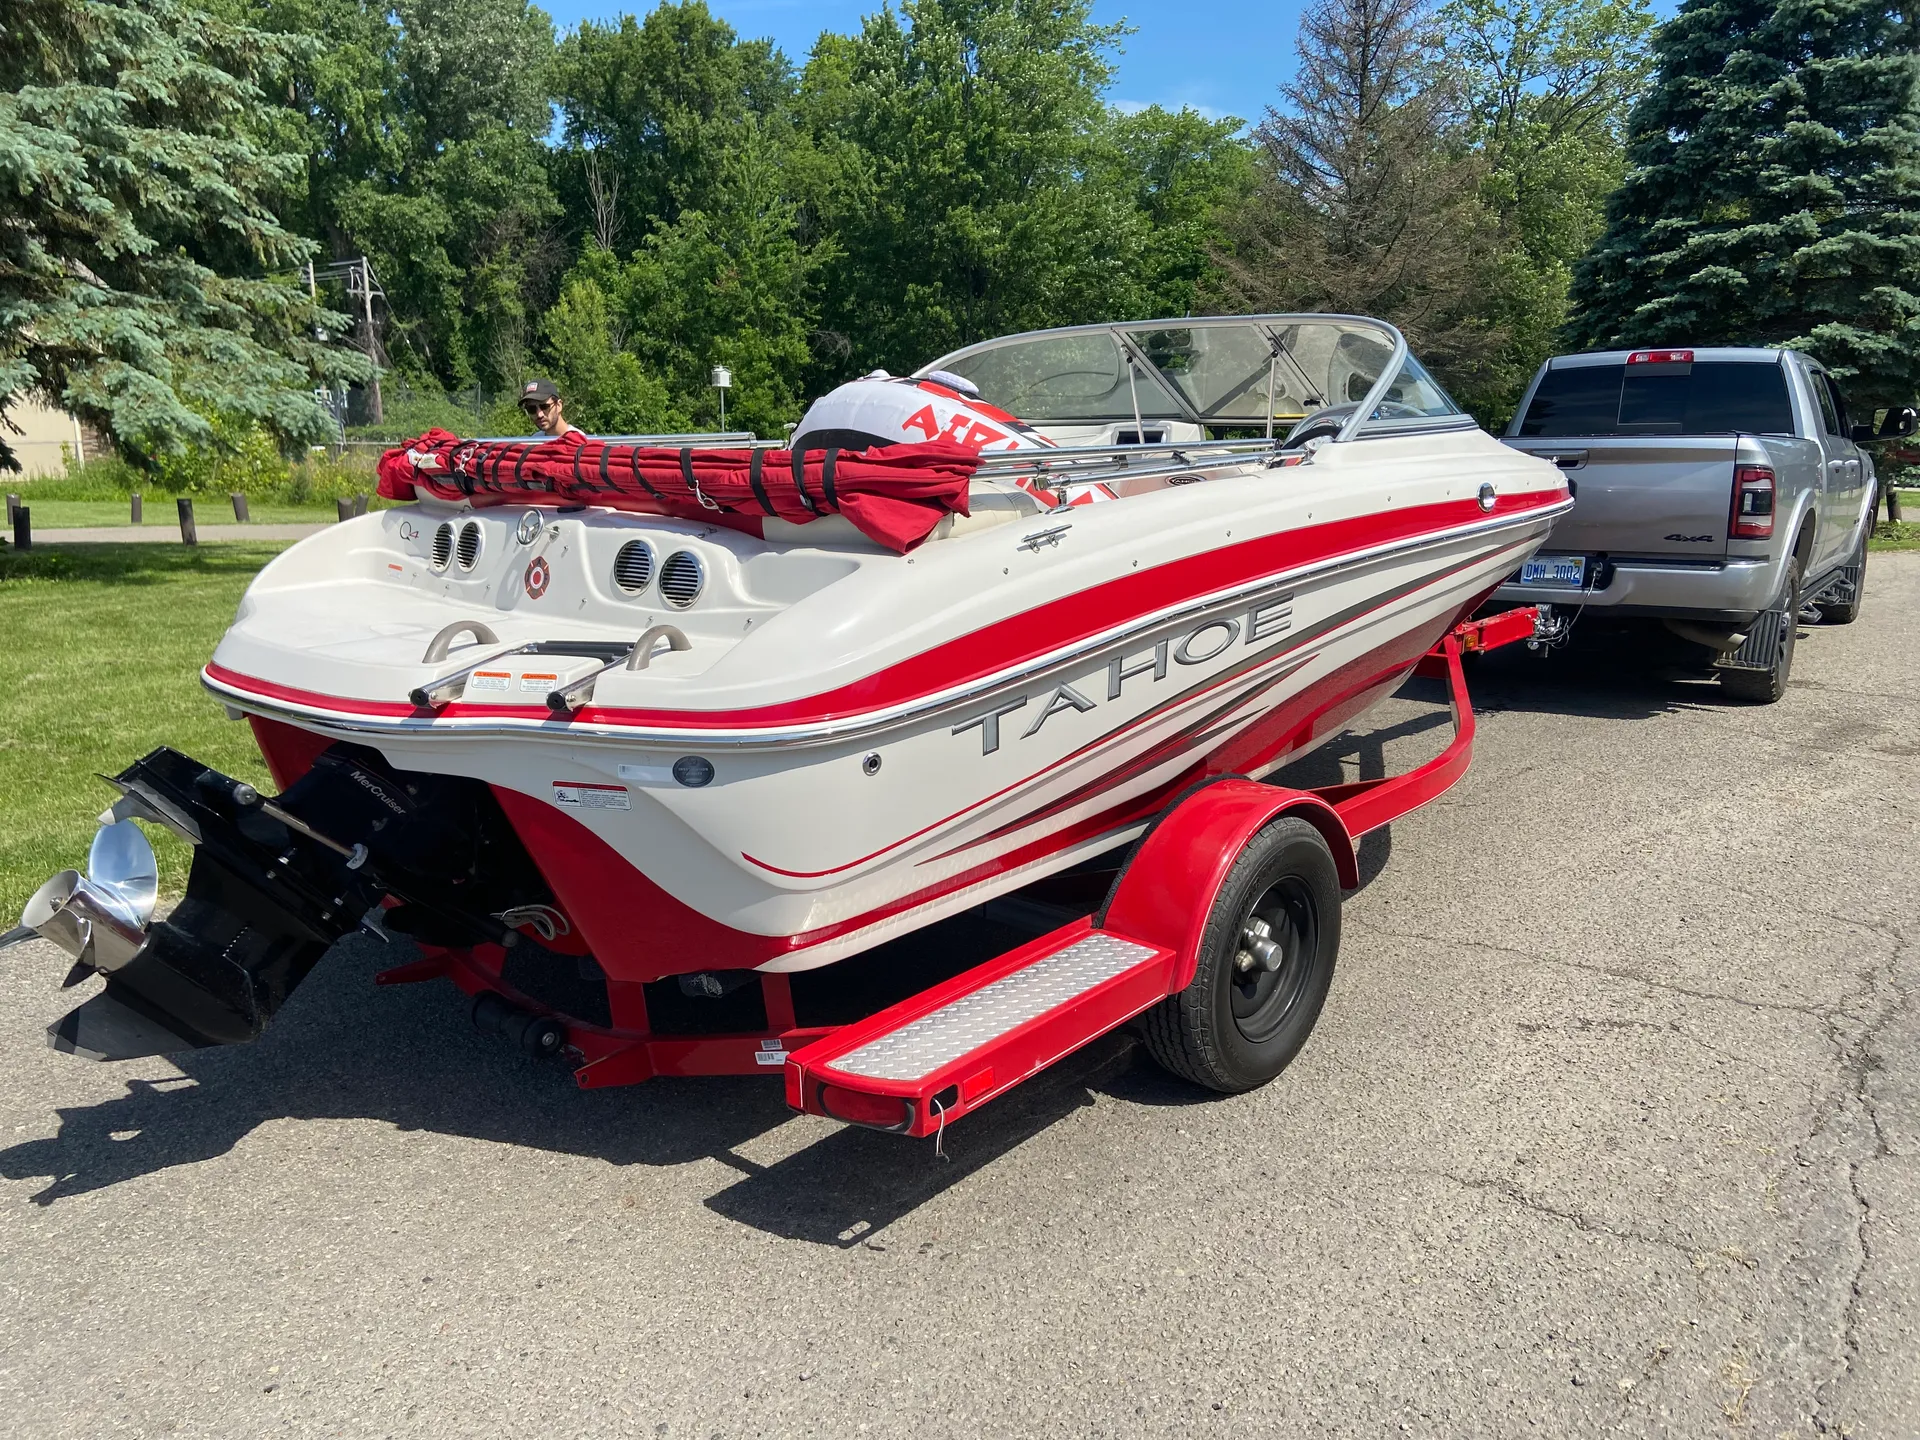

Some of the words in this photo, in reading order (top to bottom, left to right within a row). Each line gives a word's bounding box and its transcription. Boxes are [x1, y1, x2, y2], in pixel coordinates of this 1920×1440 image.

[901, 403, 1019, 451] AIR
[399, 521, 419, 541] Q4
[1663, 533, 1714, 542] 4x4
[1525, 563, 1547, 579] DMH
[1552, 564, 1581, 580] 3002
[951, 592, 1295, 757] TAHOE
[350, 770, 406, 814] MerCruiser
